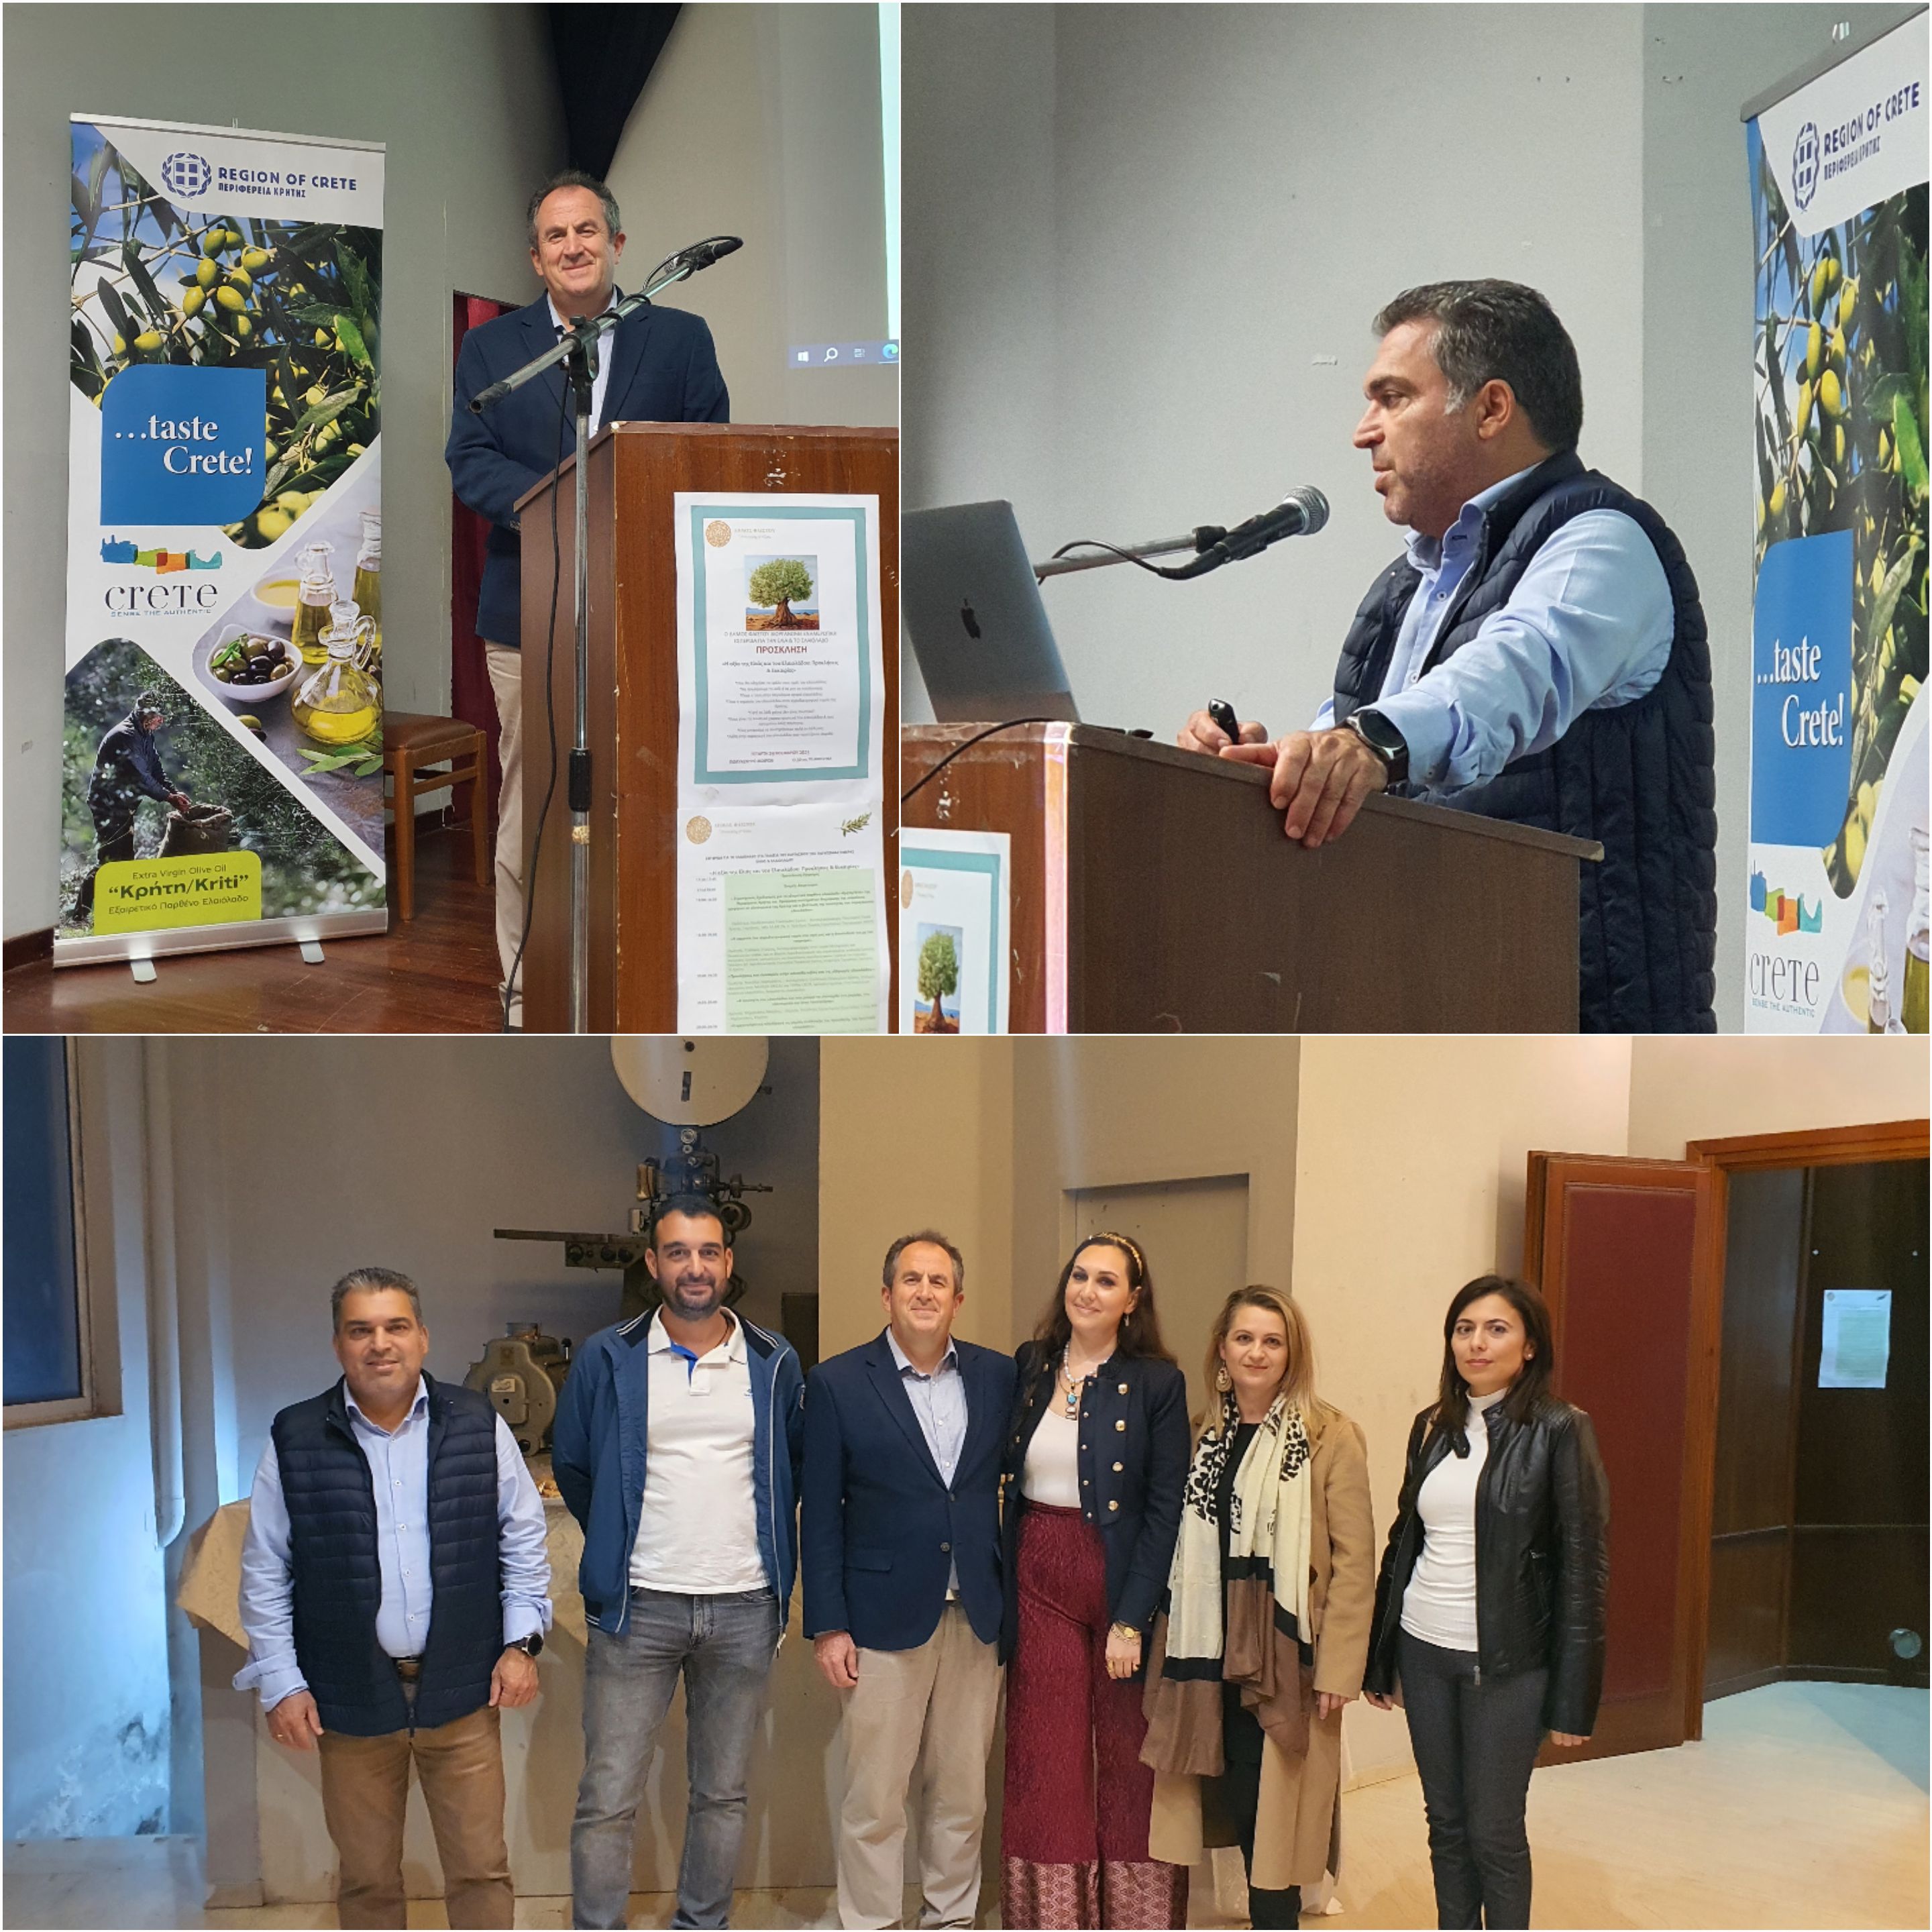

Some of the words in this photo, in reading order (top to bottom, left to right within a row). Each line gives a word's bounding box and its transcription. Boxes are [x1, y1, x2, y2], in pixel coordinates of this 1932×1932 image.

[1824, 113, 1864, 157] REGION
[1866, 103, 1882, 131] OF
[1885, 81, 1920, 121] CRETE
[218, 167, 280, 184] REGION
[286, 173, 307, 186] OF
[311, 175, 357, 191] CRETE
[218, 182, 271, 195] ΠΕΡΙΦΕΡΕΙΑ
[274, 187, 306, 198] ΚΡΗΤΗΣ
[163, 445, 254, 475] Crete!
[756, 646, 807, 654] ΠΡΟΣΚΛΗΣΗ
[1782, 692, 1844, 747] Crete!
[133, 872, 157, 880] Extra
[160, 869, 186, 877] Virgin
[189, 867, 212, 875] Olive
[215, 864, 226, 872] Oil
[109, 904, 157, 914] Εξαιρετικό
[160, 900, 199, 910] Παρθένο
[203, 895, 249, 906] Ελαιόλαδο
